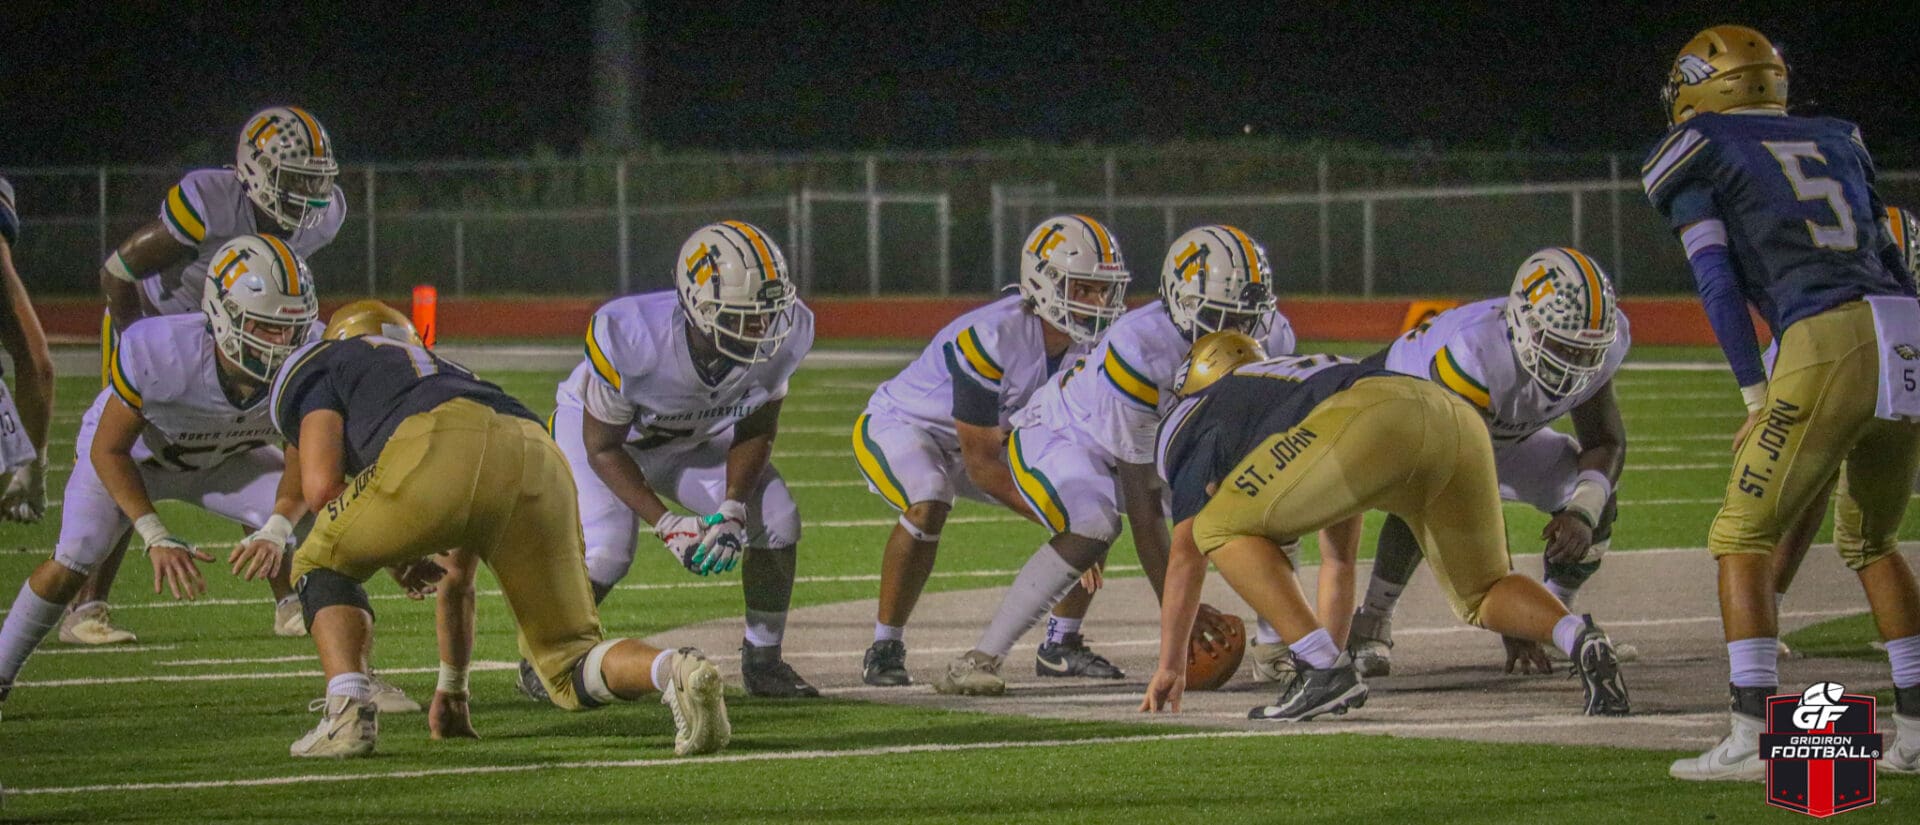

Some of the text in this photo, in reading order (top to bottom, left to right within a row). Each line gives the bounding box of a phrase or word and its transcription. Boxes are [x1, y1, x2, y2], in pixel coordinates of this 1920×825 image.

[1761, 141, 1858, 252] 5
[1904, 369, 1916, 392] 5
[697, 405, 759, 419] IBERVILL
[178, 431, 222, 441] NORTH
[1739, 398, 1800, 498] ST. JOHN
[1235, 428, 1317, 497] ST. JOHN
